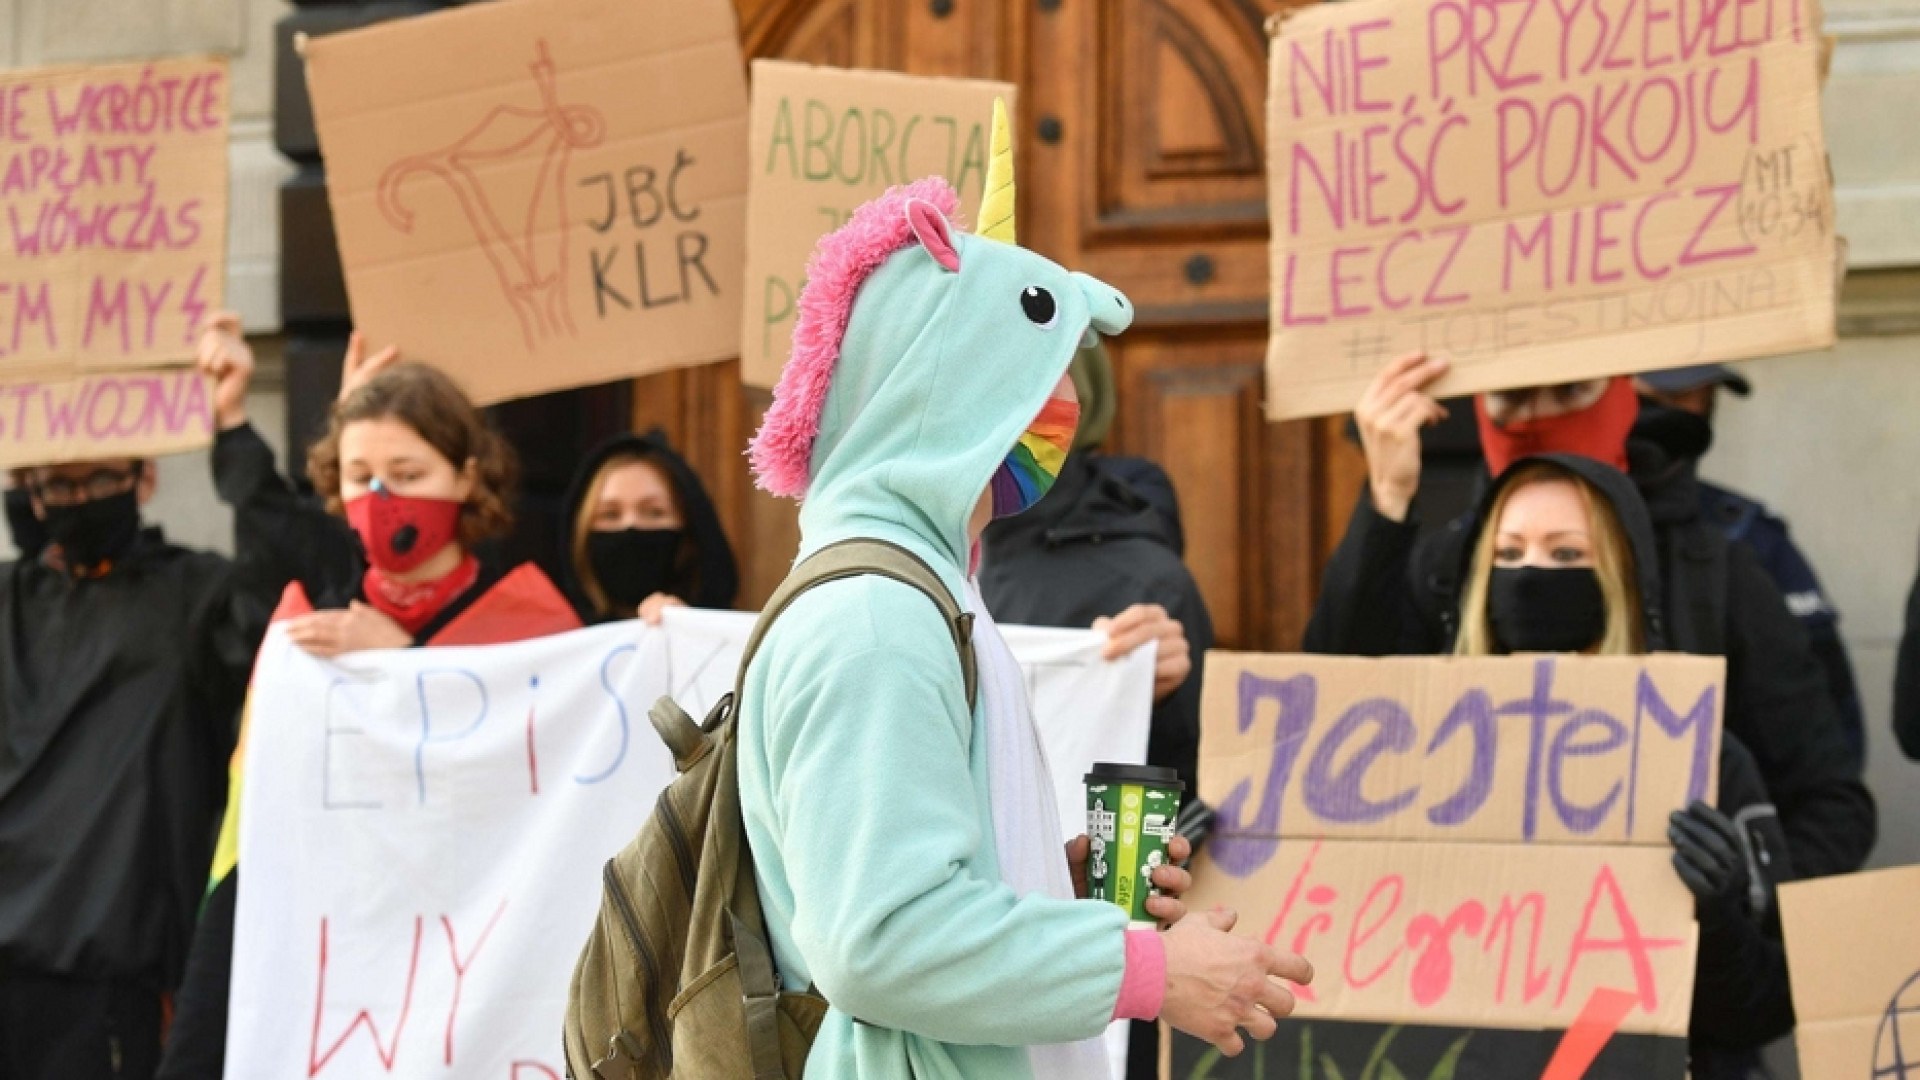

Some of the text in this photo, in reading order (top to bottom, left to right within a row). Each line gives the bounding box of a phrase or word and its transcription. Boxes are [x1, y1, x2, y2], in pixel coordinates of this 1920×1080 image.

[46, 66, 222, 136] WKRÓTCE
[1290, 19, 1392, 118] NIE
[765, 97, 986, 196] ABORCJA
[1289, 57, 1759, 236] NIEŚĆ POKOJU
[590, 231, 721, 319] KLR
[1282, 183, 1758, 326] LECZ MIECZ
[308, 899, 509, 1078] WY
